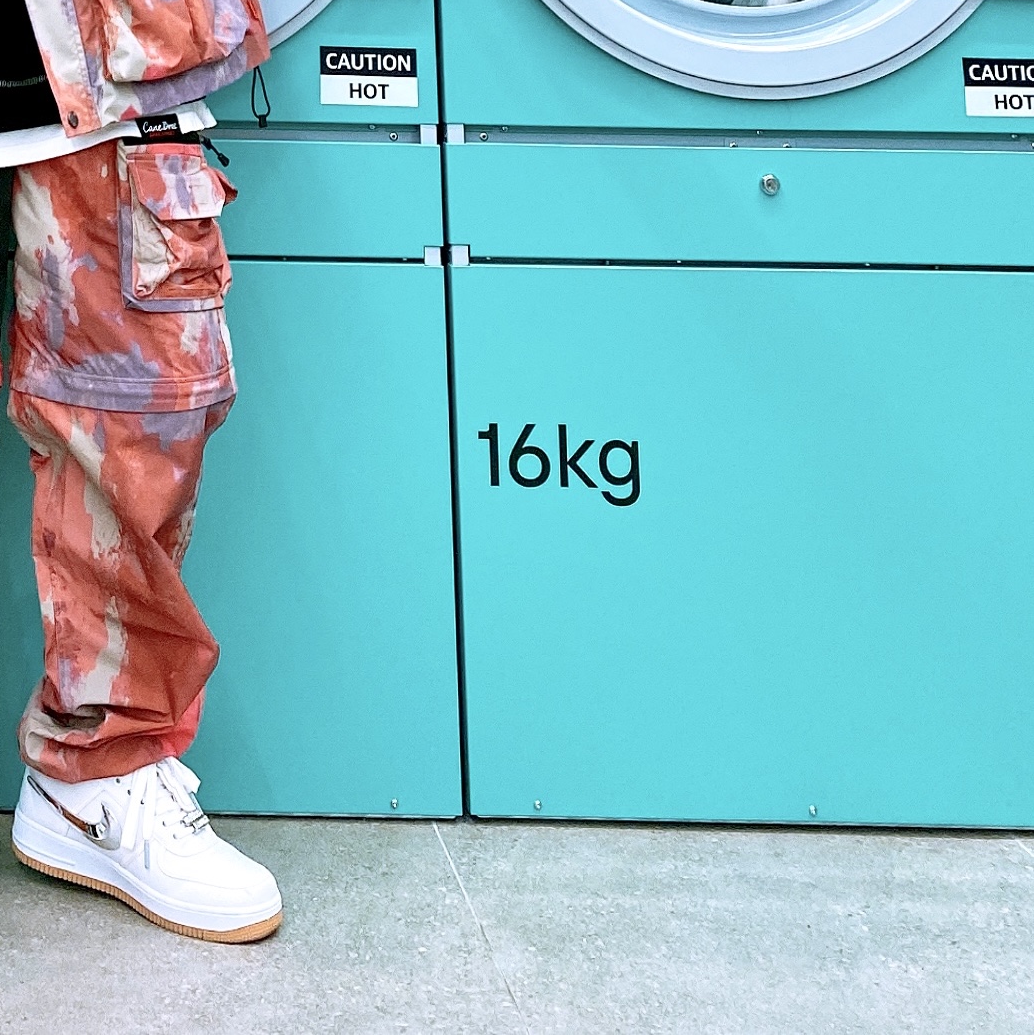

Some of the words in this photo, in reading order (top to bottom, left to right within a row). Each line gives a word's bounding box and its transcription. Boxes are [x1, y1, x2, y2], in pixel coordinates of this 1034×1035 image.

[326, 52, 411, 71] CAUTION
[350, 83, 389, 99] HOT
[478, 422, 640, 506] 16kg
